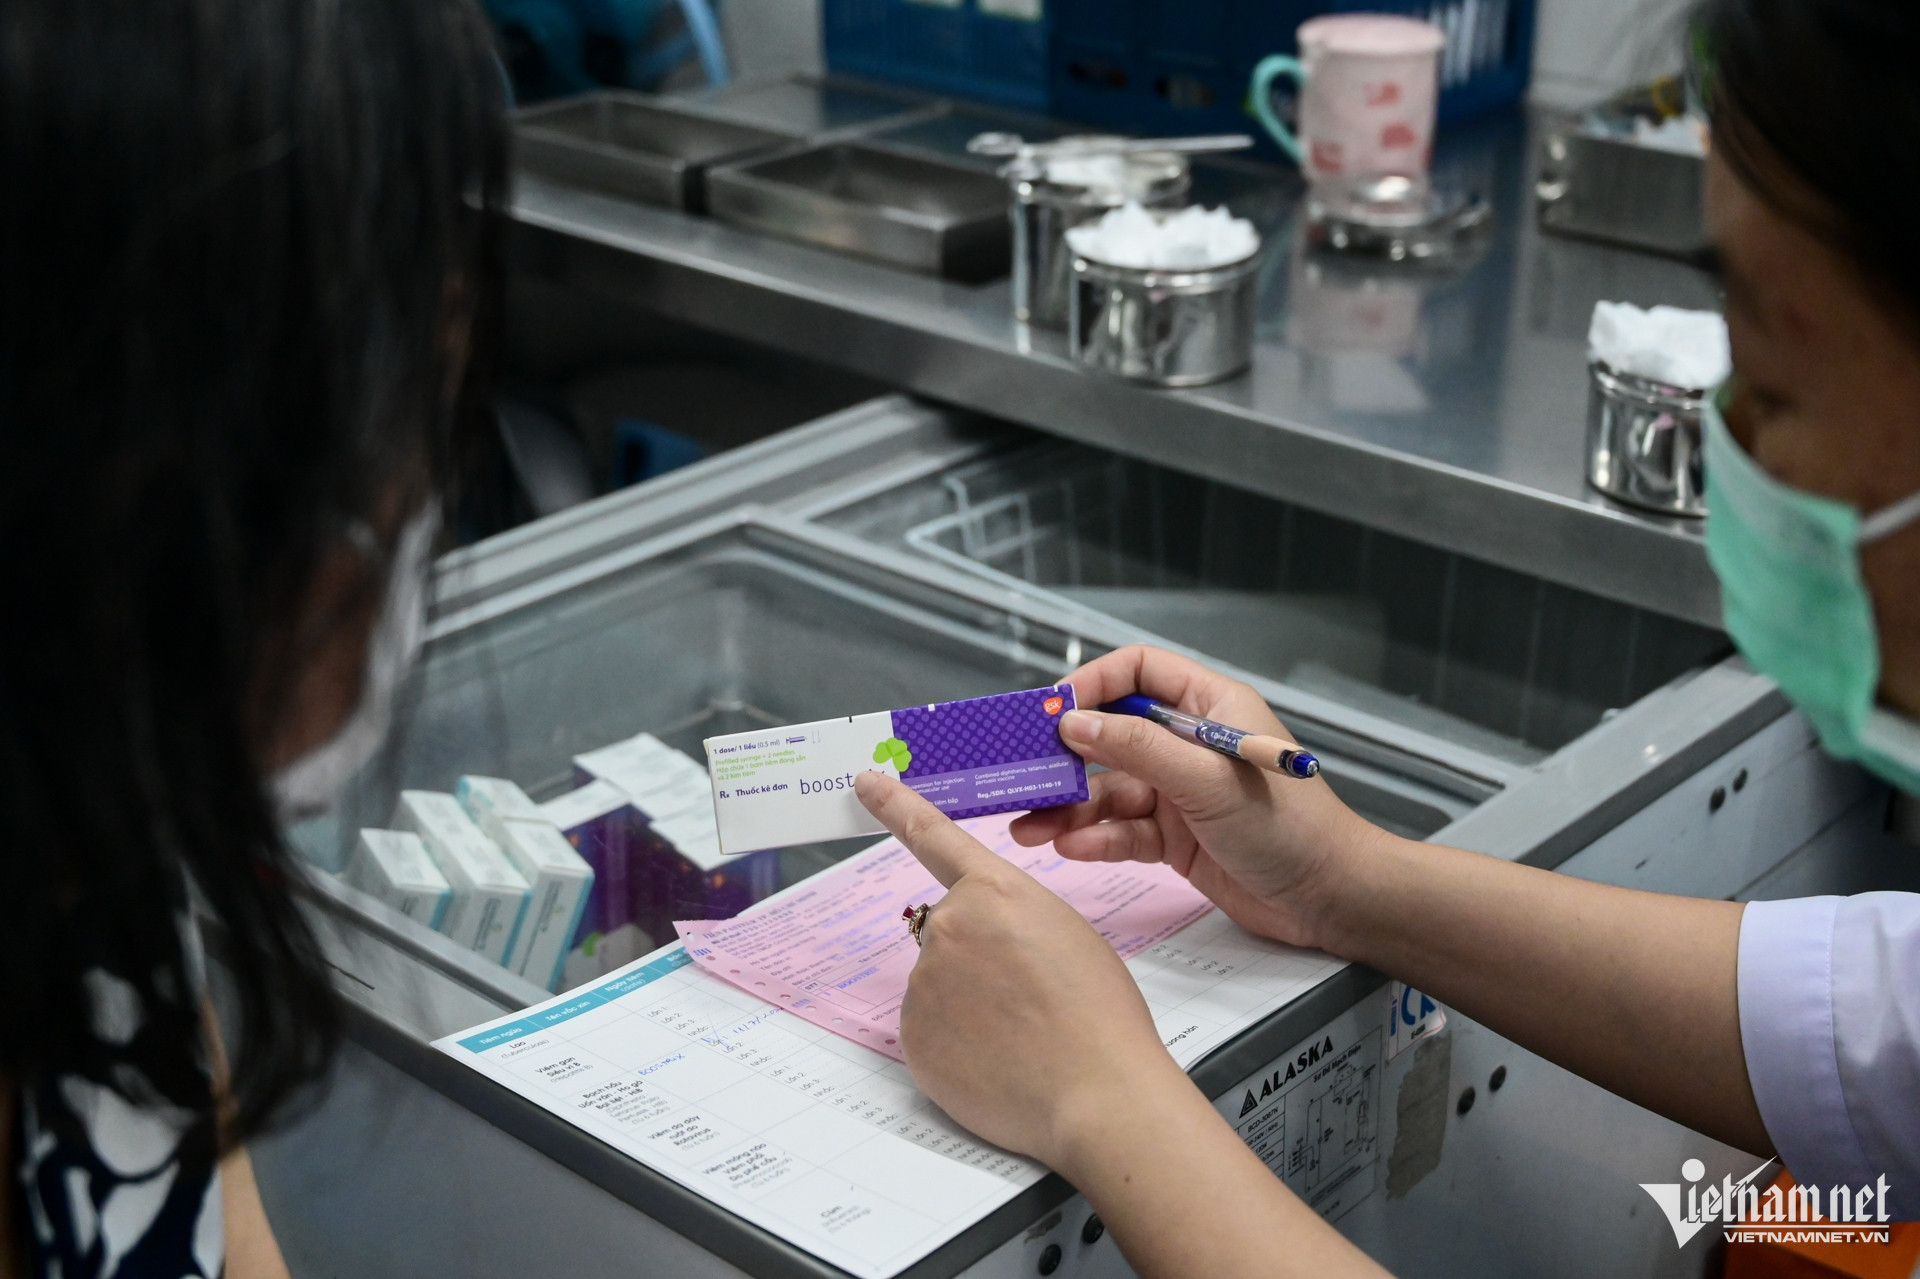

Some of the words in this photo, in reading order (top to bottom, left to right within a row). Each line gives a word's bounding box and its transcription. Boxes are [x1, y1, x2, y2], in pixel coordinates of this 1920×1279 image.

[1045, 700, 1060, 713] gsk
[736, 785, 760, 797] Thuốc
[772, 783, 788, 791] đơn
[800, 768, 885, 795] boost
[1260, 1035, 1334, 1102] ALASKA
